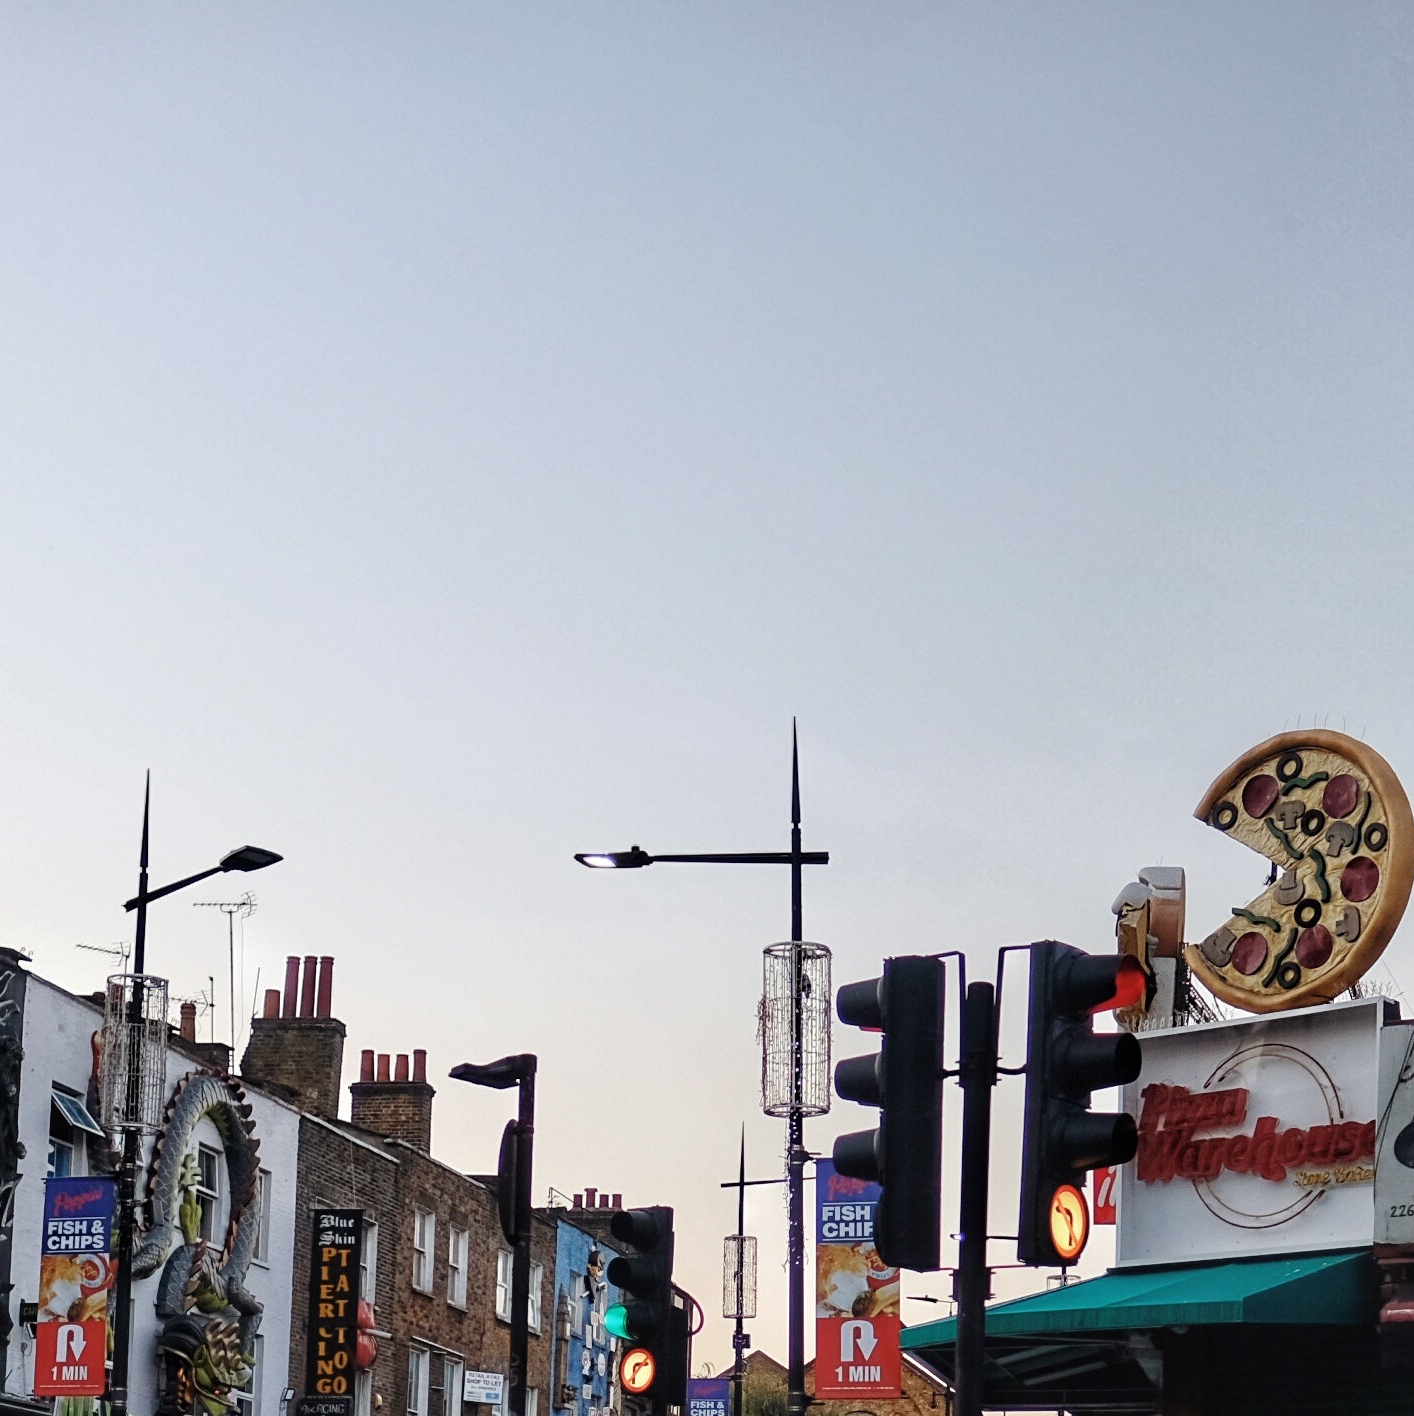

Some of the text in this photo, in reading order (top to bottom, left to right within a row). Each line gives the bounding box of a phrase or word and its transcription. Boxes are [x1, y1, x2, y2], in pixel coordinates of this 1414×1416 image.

[1137, 1116, 1377, 1183] Warehouse
[319, 1214, 355, 1229] Blue
[822, 1205, 871, 1222] FISH
[47, 1219, 105, 1236] FISH &
[822, 1222, 874, 1238] CHIP
[46, 1234, 105, 1250] CHIPS
[318, 1230, 356, 1246] Skin
[333, 1249, 351, 1394] TATTOO
[50, 1365, 88, 1381] 1 MIN
[834, 1365, 881, 1383] 1 MIN
[690, 1401, 725, 1409] FISH &
[690, 1409, 725, 1416] CHIPS
